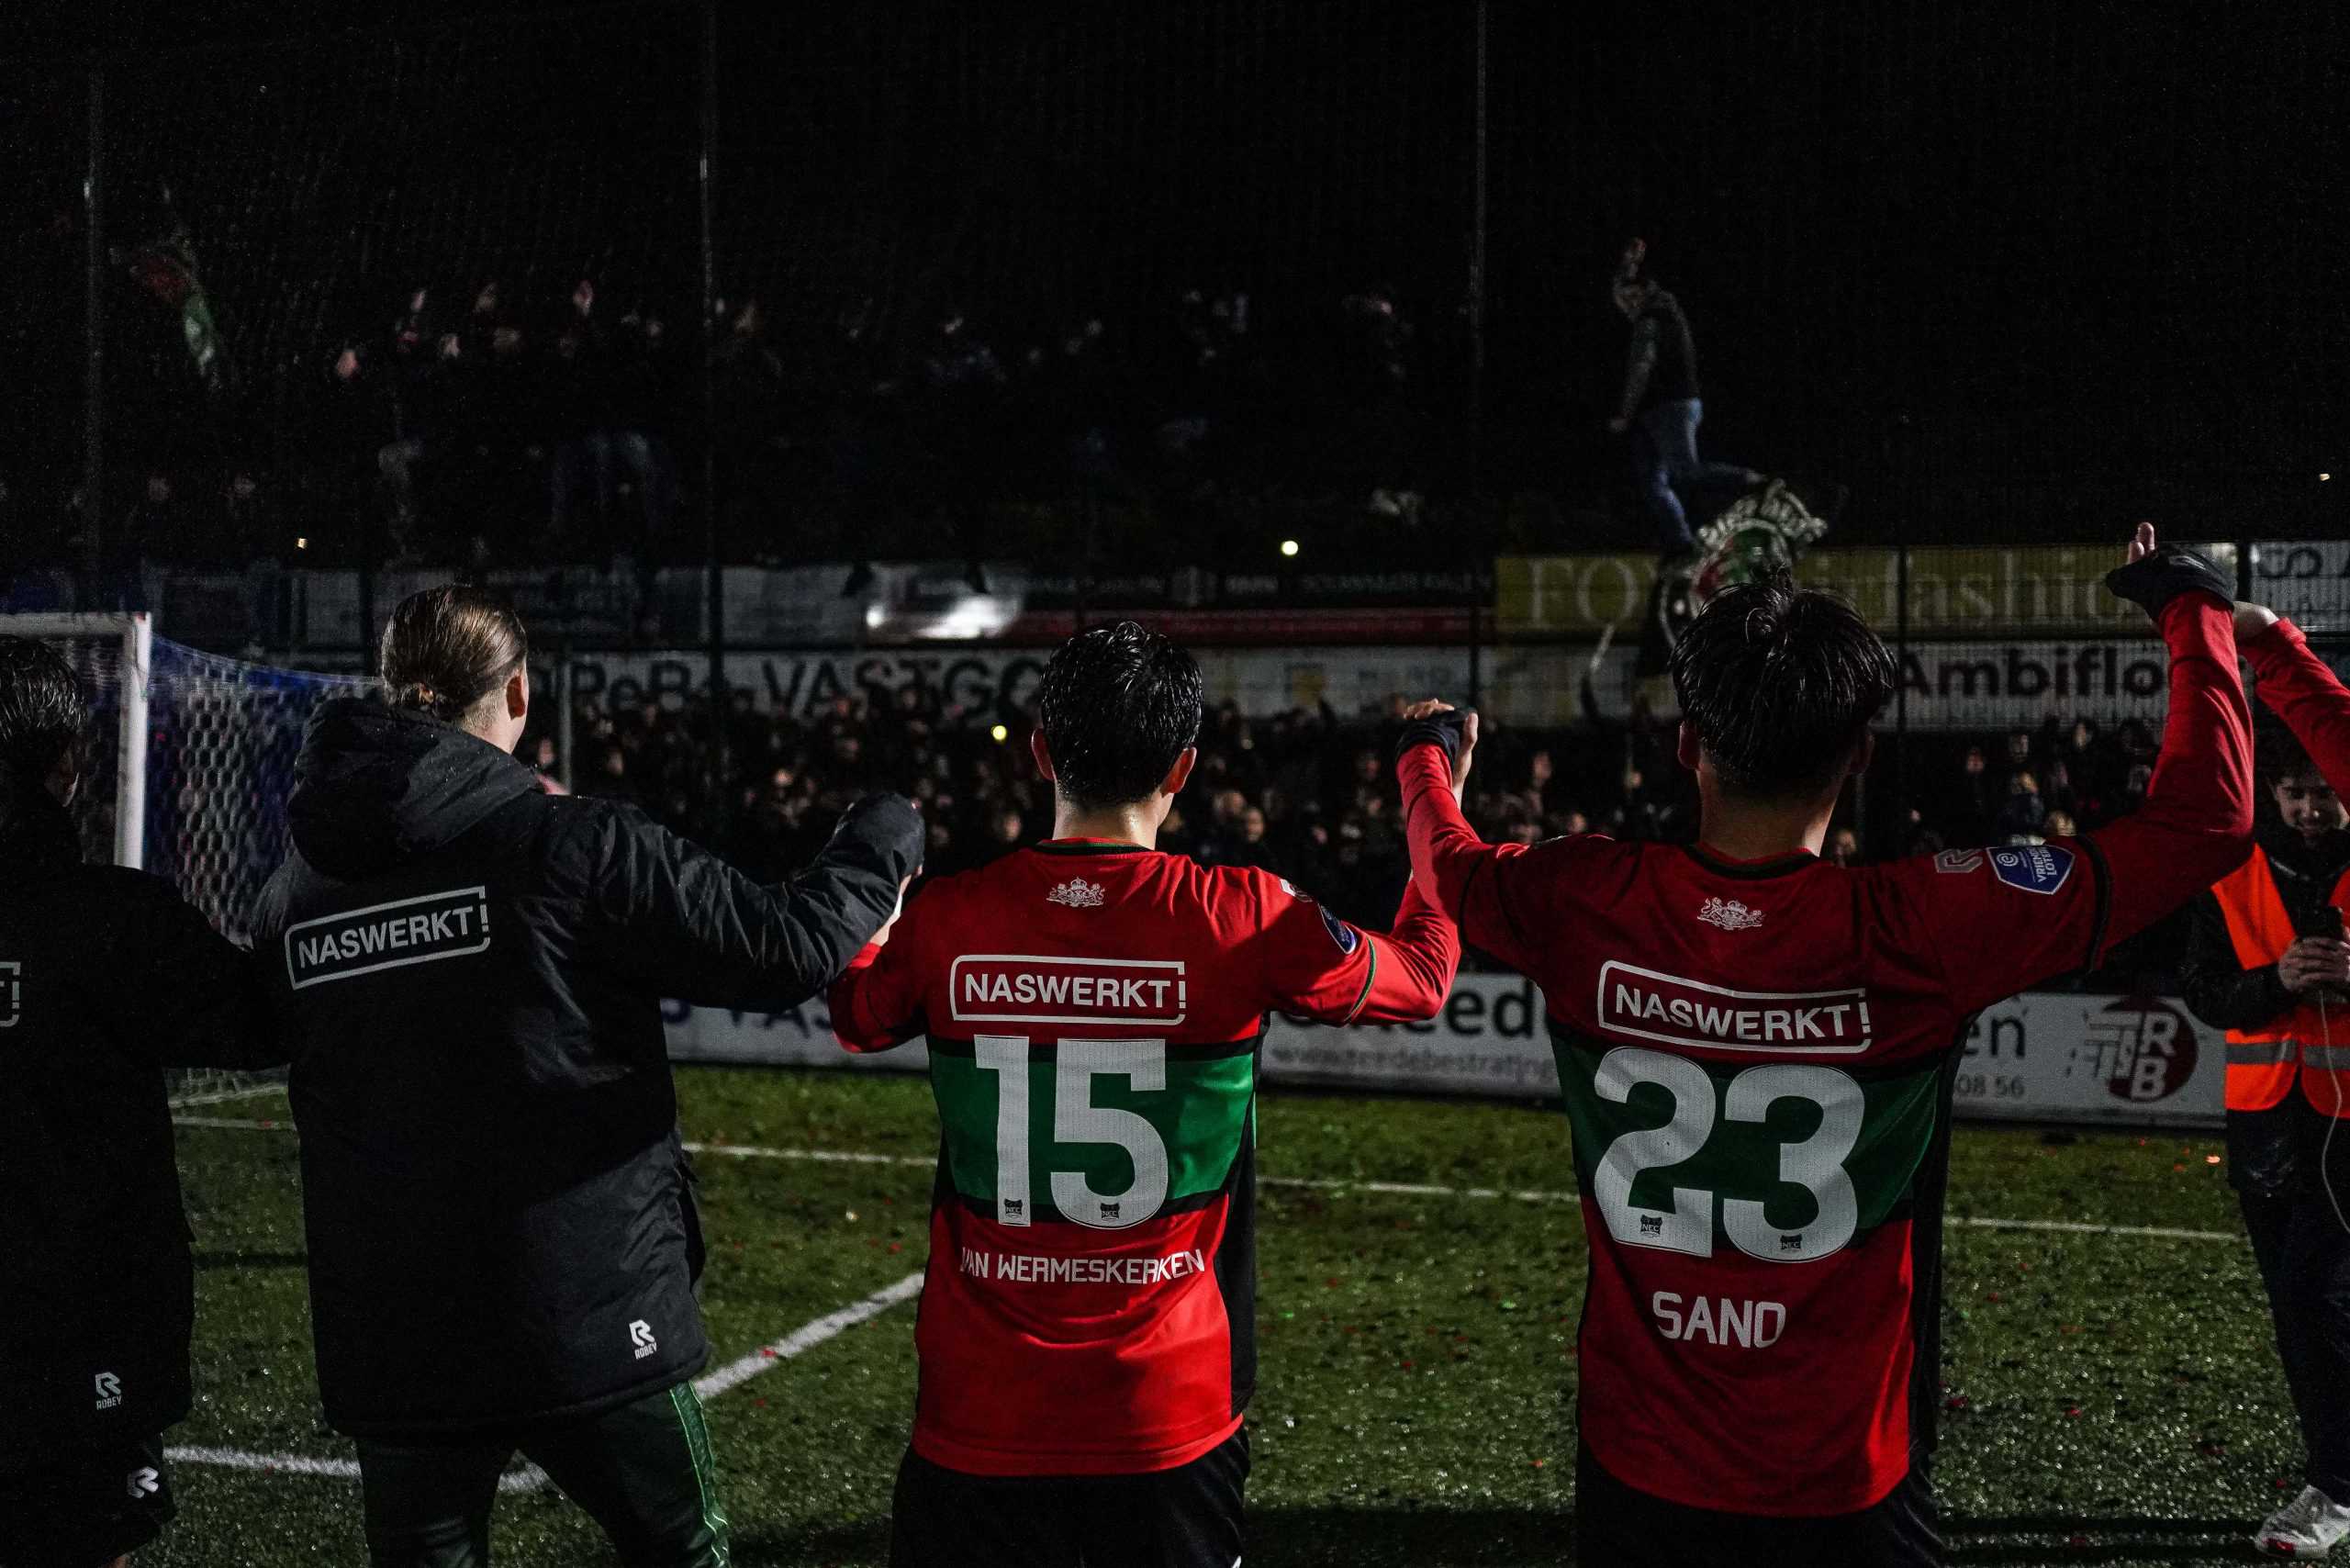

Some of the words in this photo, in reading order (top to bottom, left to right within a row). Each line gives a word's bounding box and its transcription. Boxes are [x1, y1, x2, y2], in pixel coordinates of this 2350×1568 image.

[1528, 558, 1656, 630] FO
[763, 656, 1046, 720] VASTGO
[1897, 646, 2165, 698] Ambiflo
[974, 1034, 1169, 1229] 15
[1594, 1046, 1865, 1263] 23
[960, 1247, 990, 1278] VAN
[997, 1248, 1205, 1285] WERMESKERKEN
[1653, 1291, 1786, 1349] SAND
